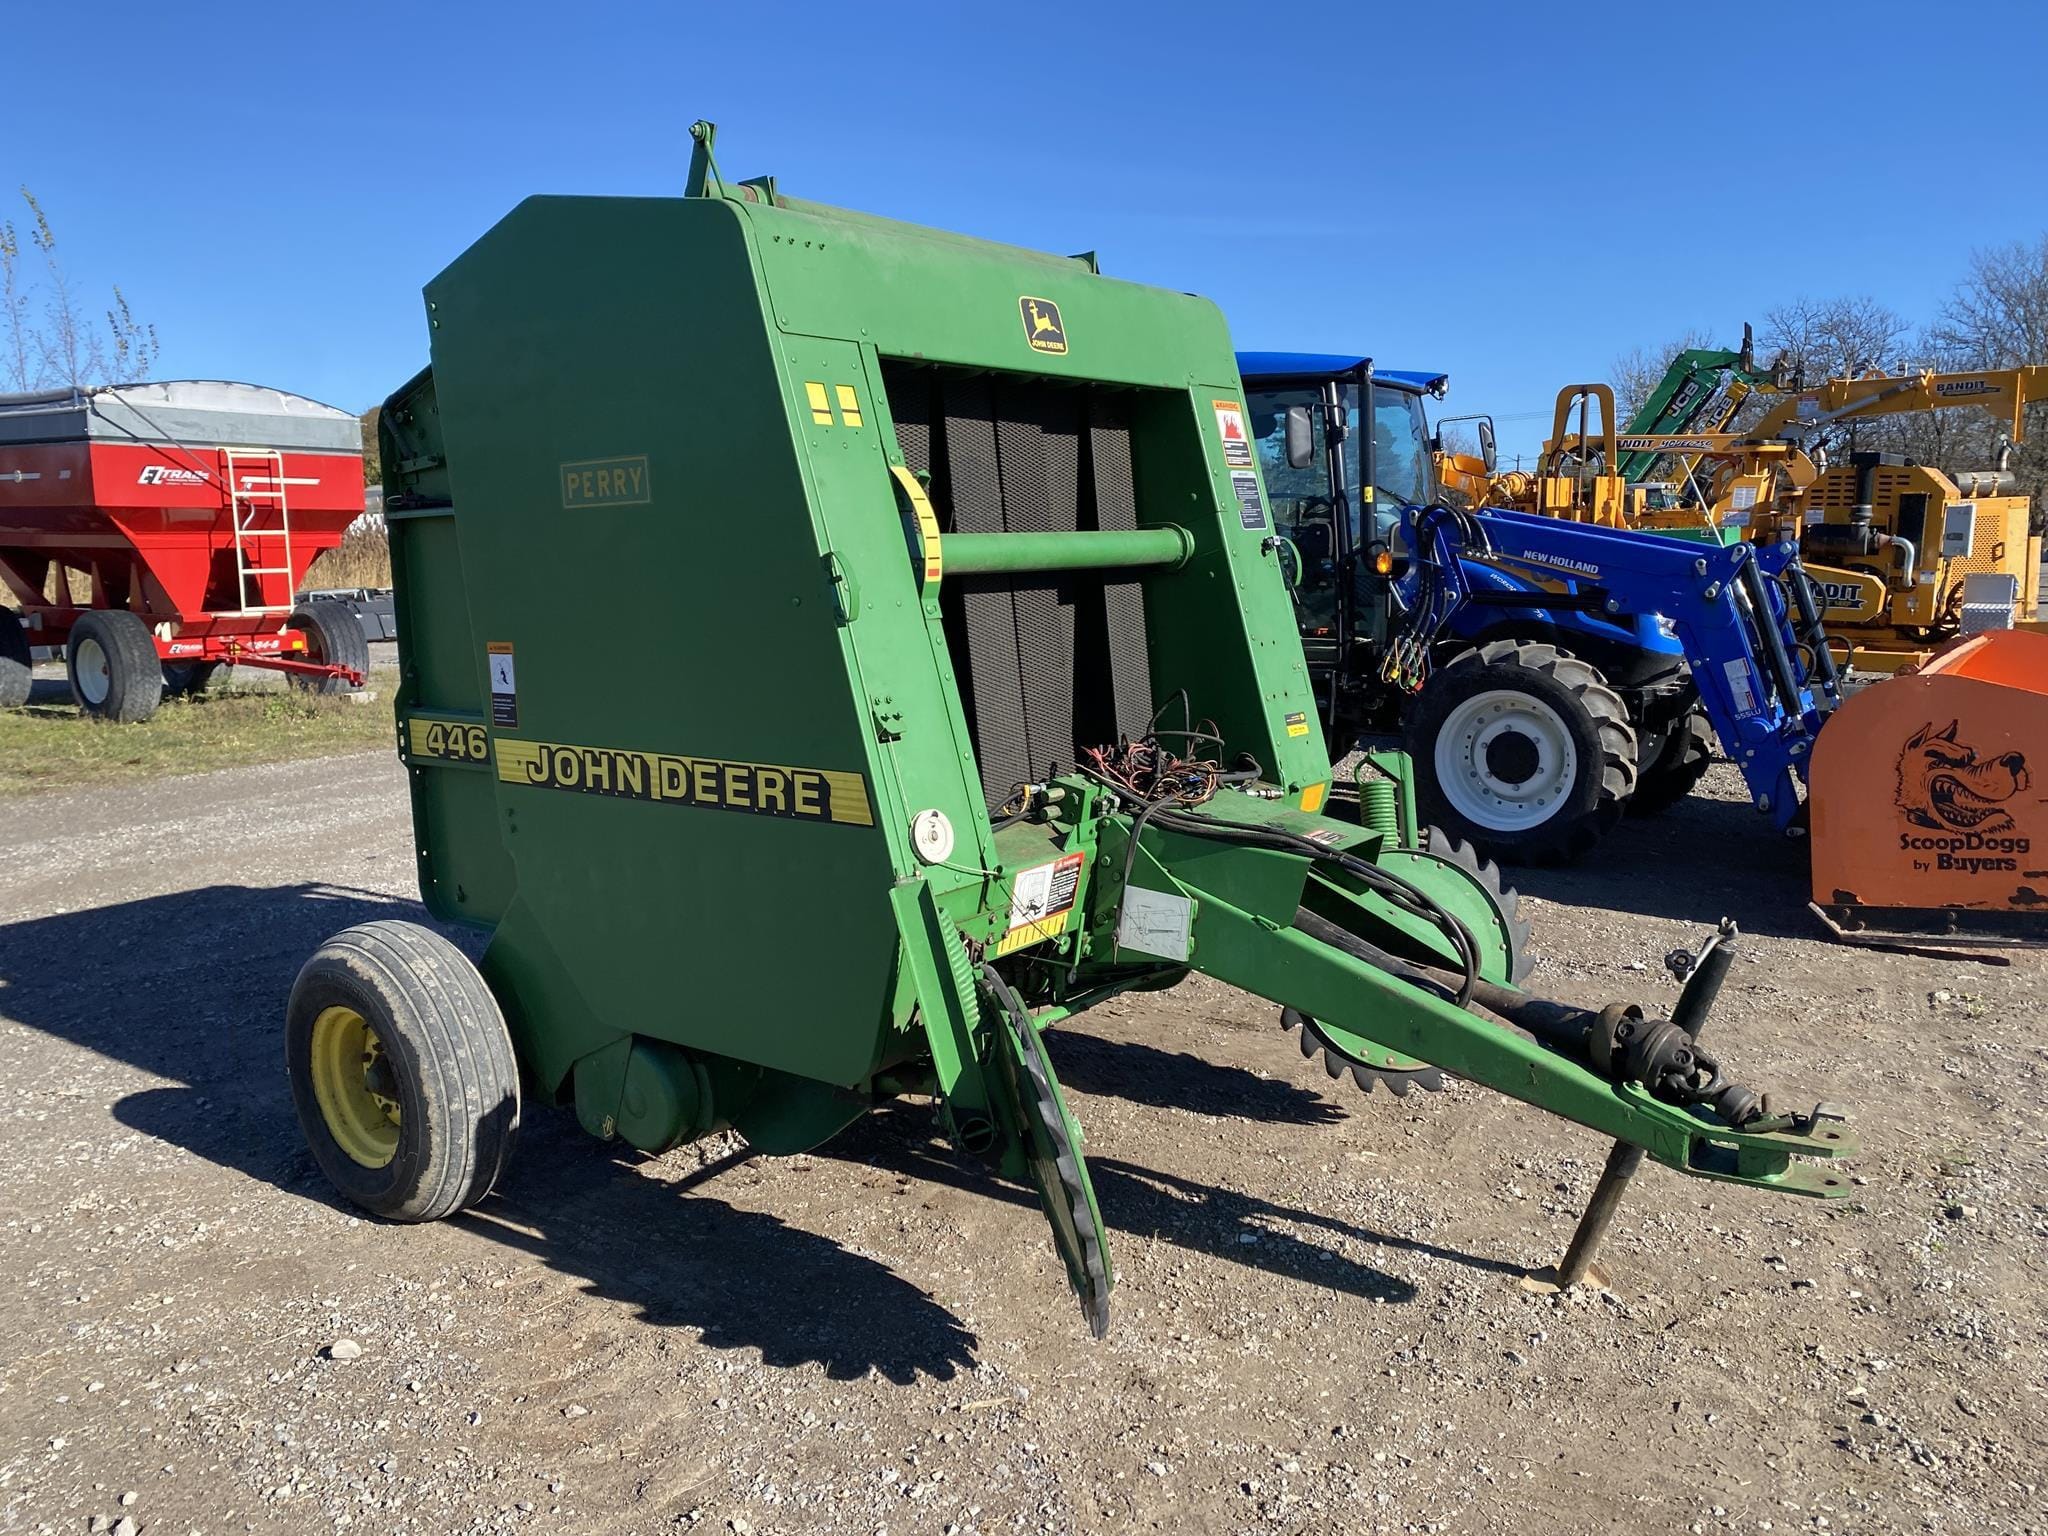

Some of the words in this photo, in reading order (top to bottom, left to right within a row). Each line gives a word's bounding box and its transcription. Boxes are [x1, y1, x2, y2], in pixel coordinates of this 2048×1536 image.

[1031, 339, 1047, 348] JOHN
[1046, 341, 1065, 351] DEERE
[1670, 381, 1700, 418] JCB
[1936, 380, 1985, 392] BANDIT
[1709, 396, 1734, 427] JCB
[566, 466, 642, 499] PERRY
[1523, 550, 1548, 562] NEW
[1549, 555, 1599, 574] HOLLAND
[427, 724, 487, 760] 446
[526, 745, 643, 795] JOHN
[659, 758, 822, 816] DEERE
[1900, 832, 2030, 854] ScoopDogg
[1913, 860, 1931, 872] by
[1936, 853, 2018, 875] Buyers
